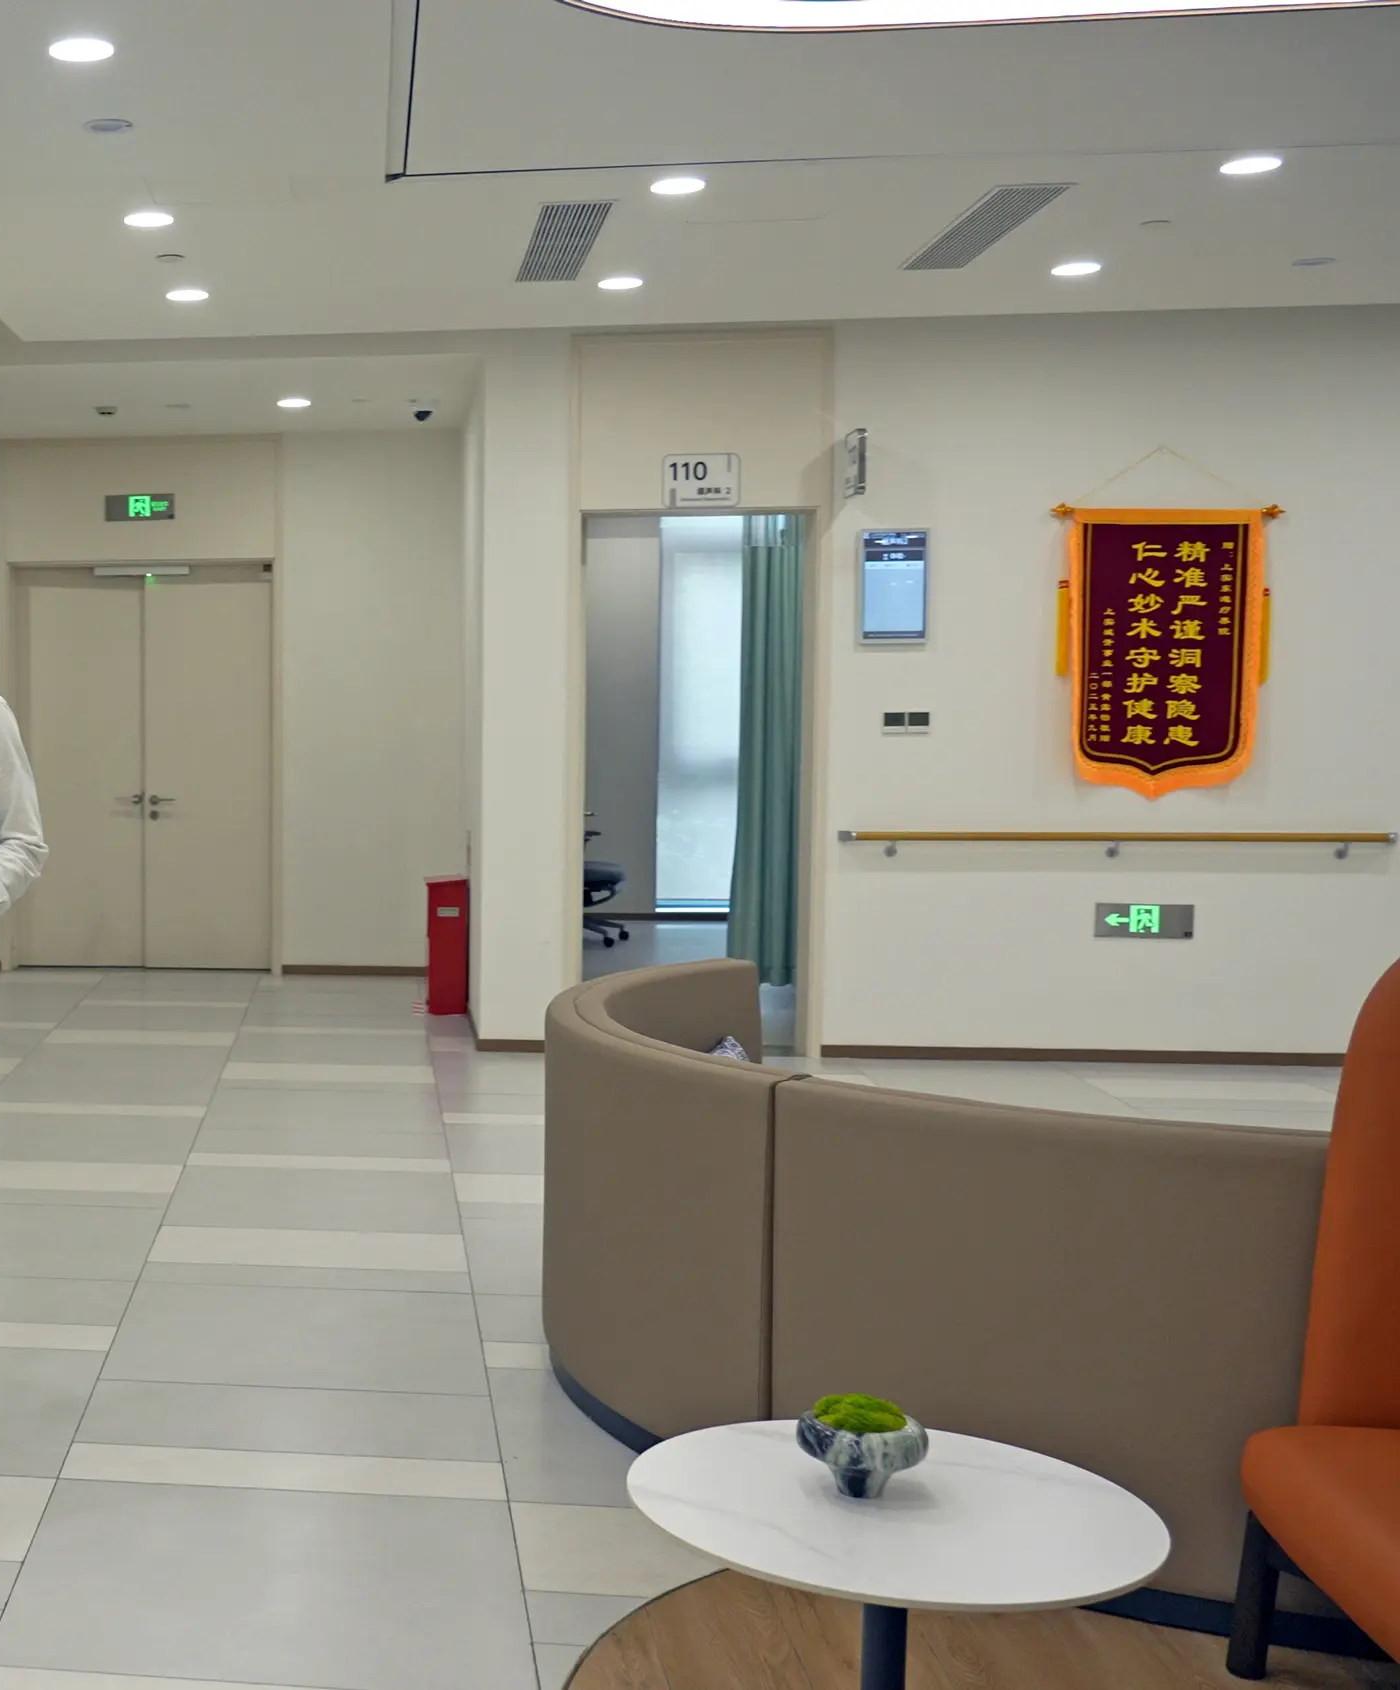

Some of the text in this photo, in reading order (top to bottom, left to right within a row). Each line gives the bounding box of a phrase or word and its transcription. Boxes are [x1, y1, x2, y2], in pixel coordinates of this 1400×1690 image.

[669, 461, 707, 481] 110
[1120, 541, 1168, 745] 仁心妙术守护健康
[1163, 541, 1211, 747] 精准严谨洞察隐患
